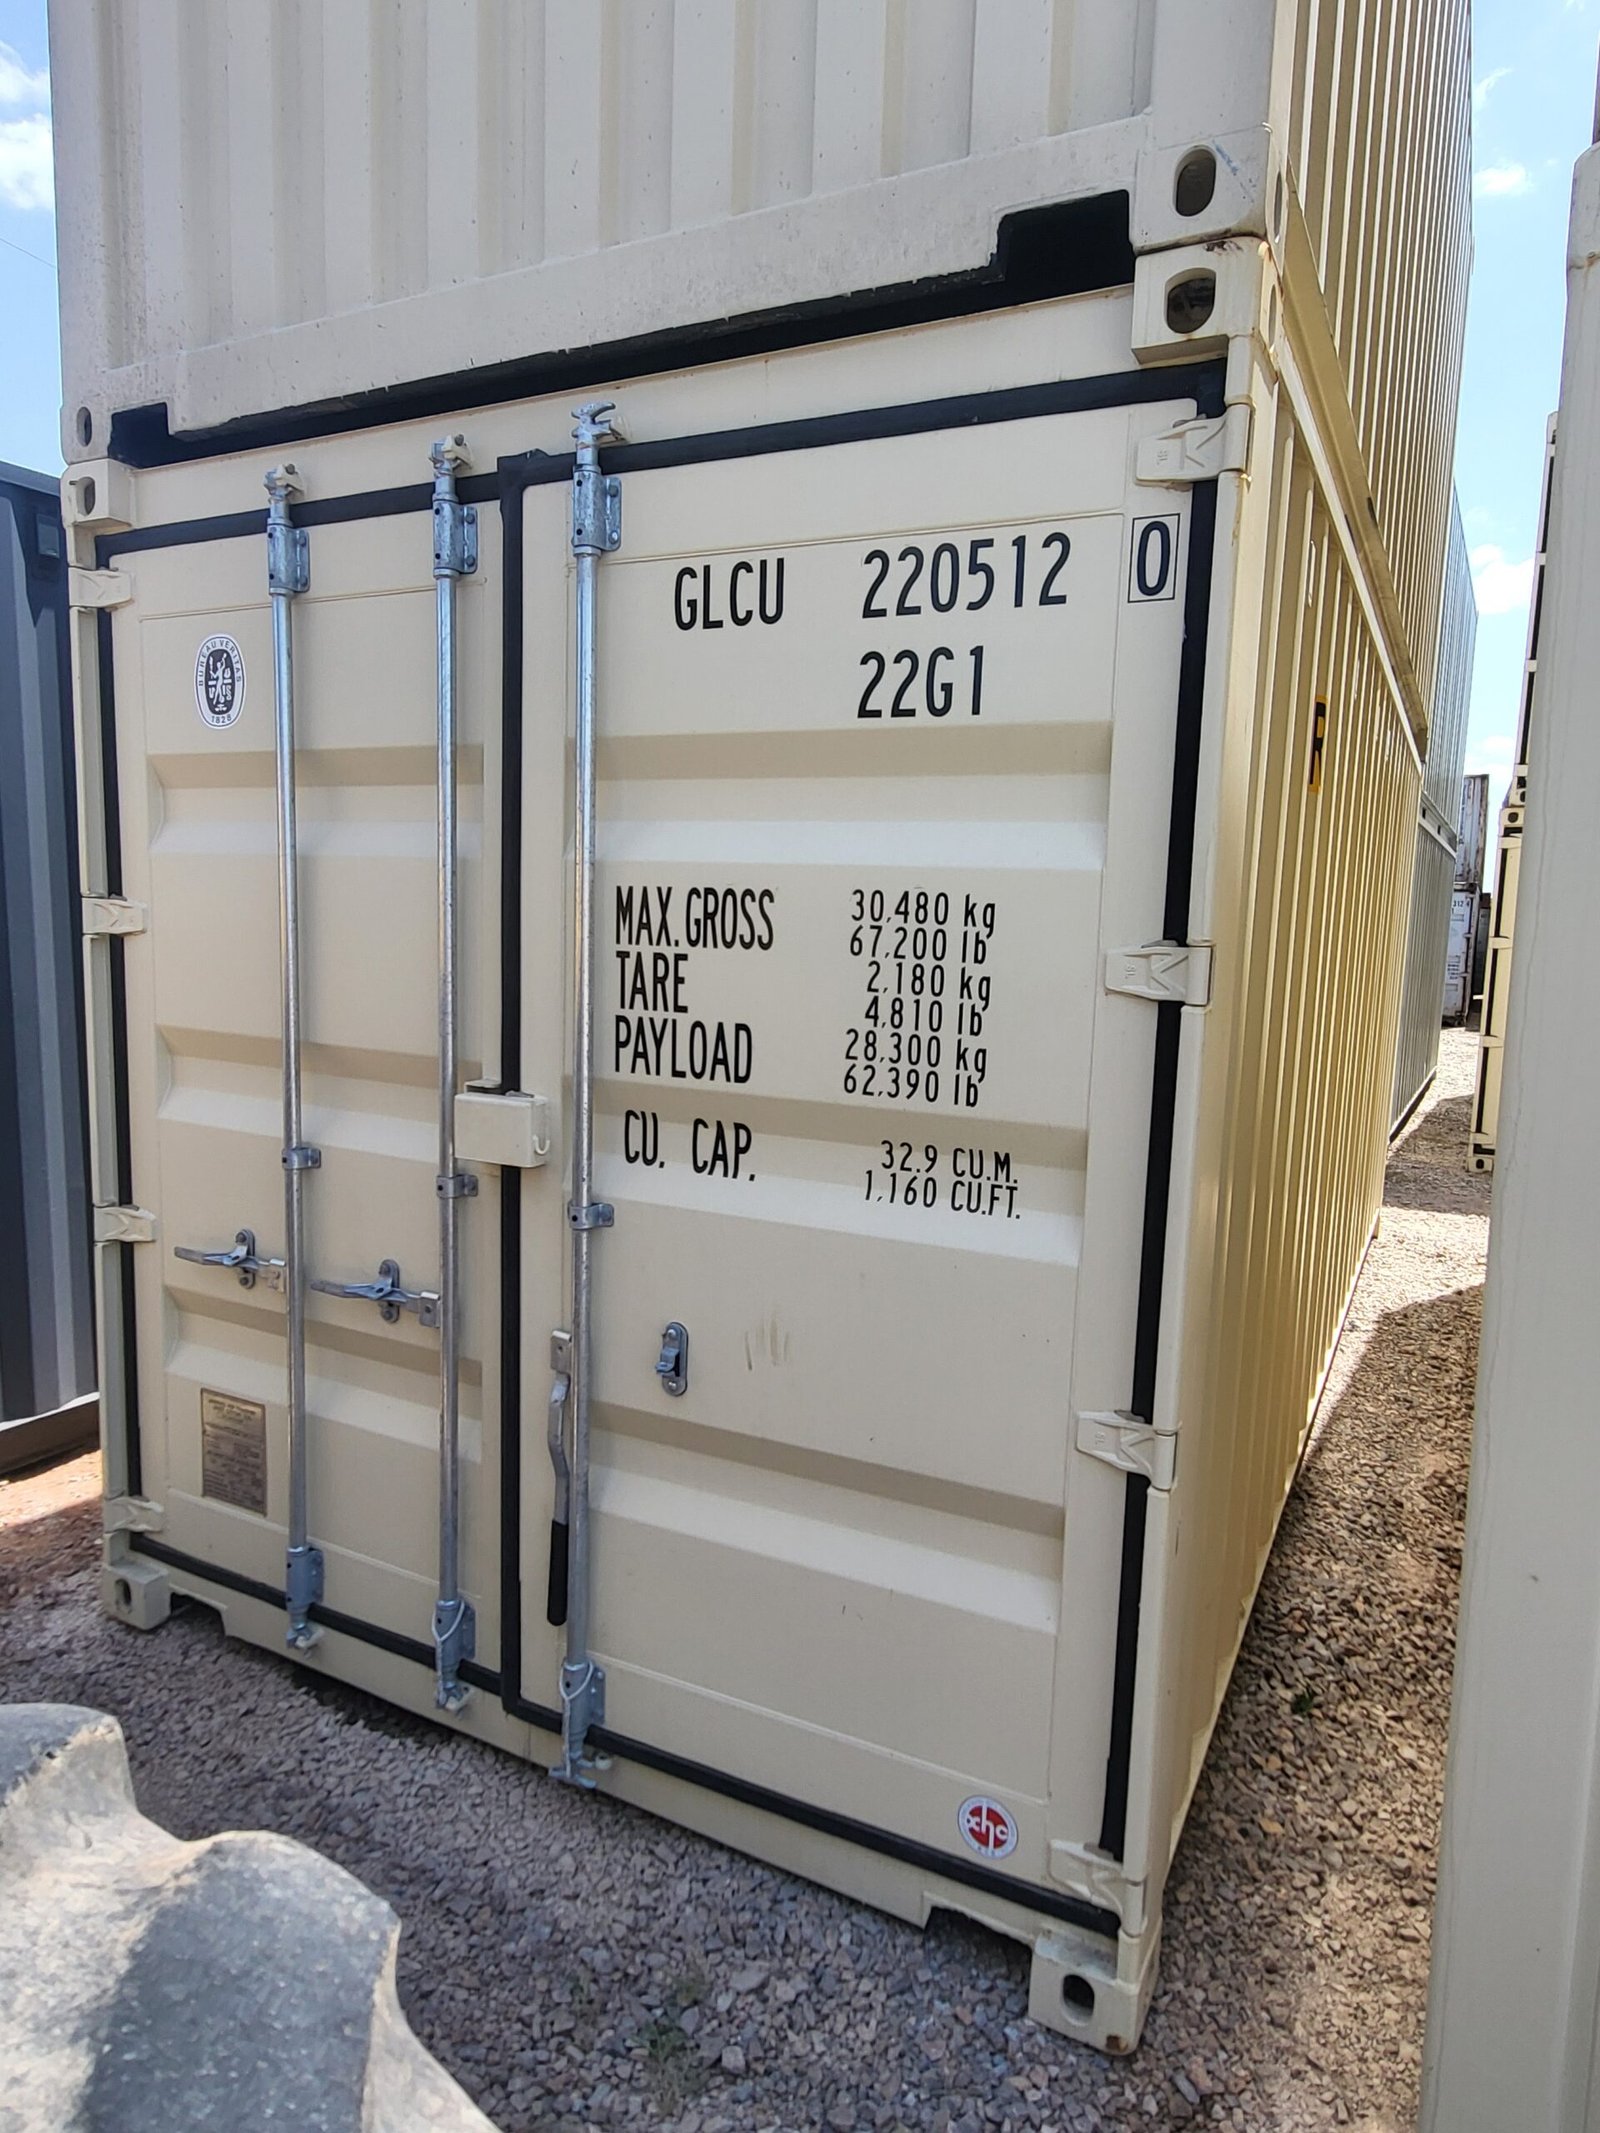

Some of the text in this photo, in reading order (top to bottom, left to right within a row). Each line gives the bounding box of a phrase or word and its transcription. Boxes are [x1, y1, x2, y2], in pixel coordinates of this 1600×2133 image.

[674, 557, 785, 631] GLCU
[862, 531, 1071, 619] 220512
[857, 645, 984, 718] 22G1
[851, 889, 996, 939] 30,480 kg
[849, 924, 987, 965] 67,200 lb
[615, 950, 689, 1014] TARE
[866, 960, 992, 1012] 2,180 kg
[864, 995, 983, 1037] 4,810 lb
[614, 1014, 753, 1084] PAYLOAD
[845, 1028, 988, 1084] 28,300 kg
[843, 1063, 979, 1108] 62,390 lb
[624, 1109, 756, 1182] CU. CAP.
[880, 1139, 1019, 1184] 32.9 CU.M.
[864, 1170, 1022, 1219] 1,160 CU.FT.
